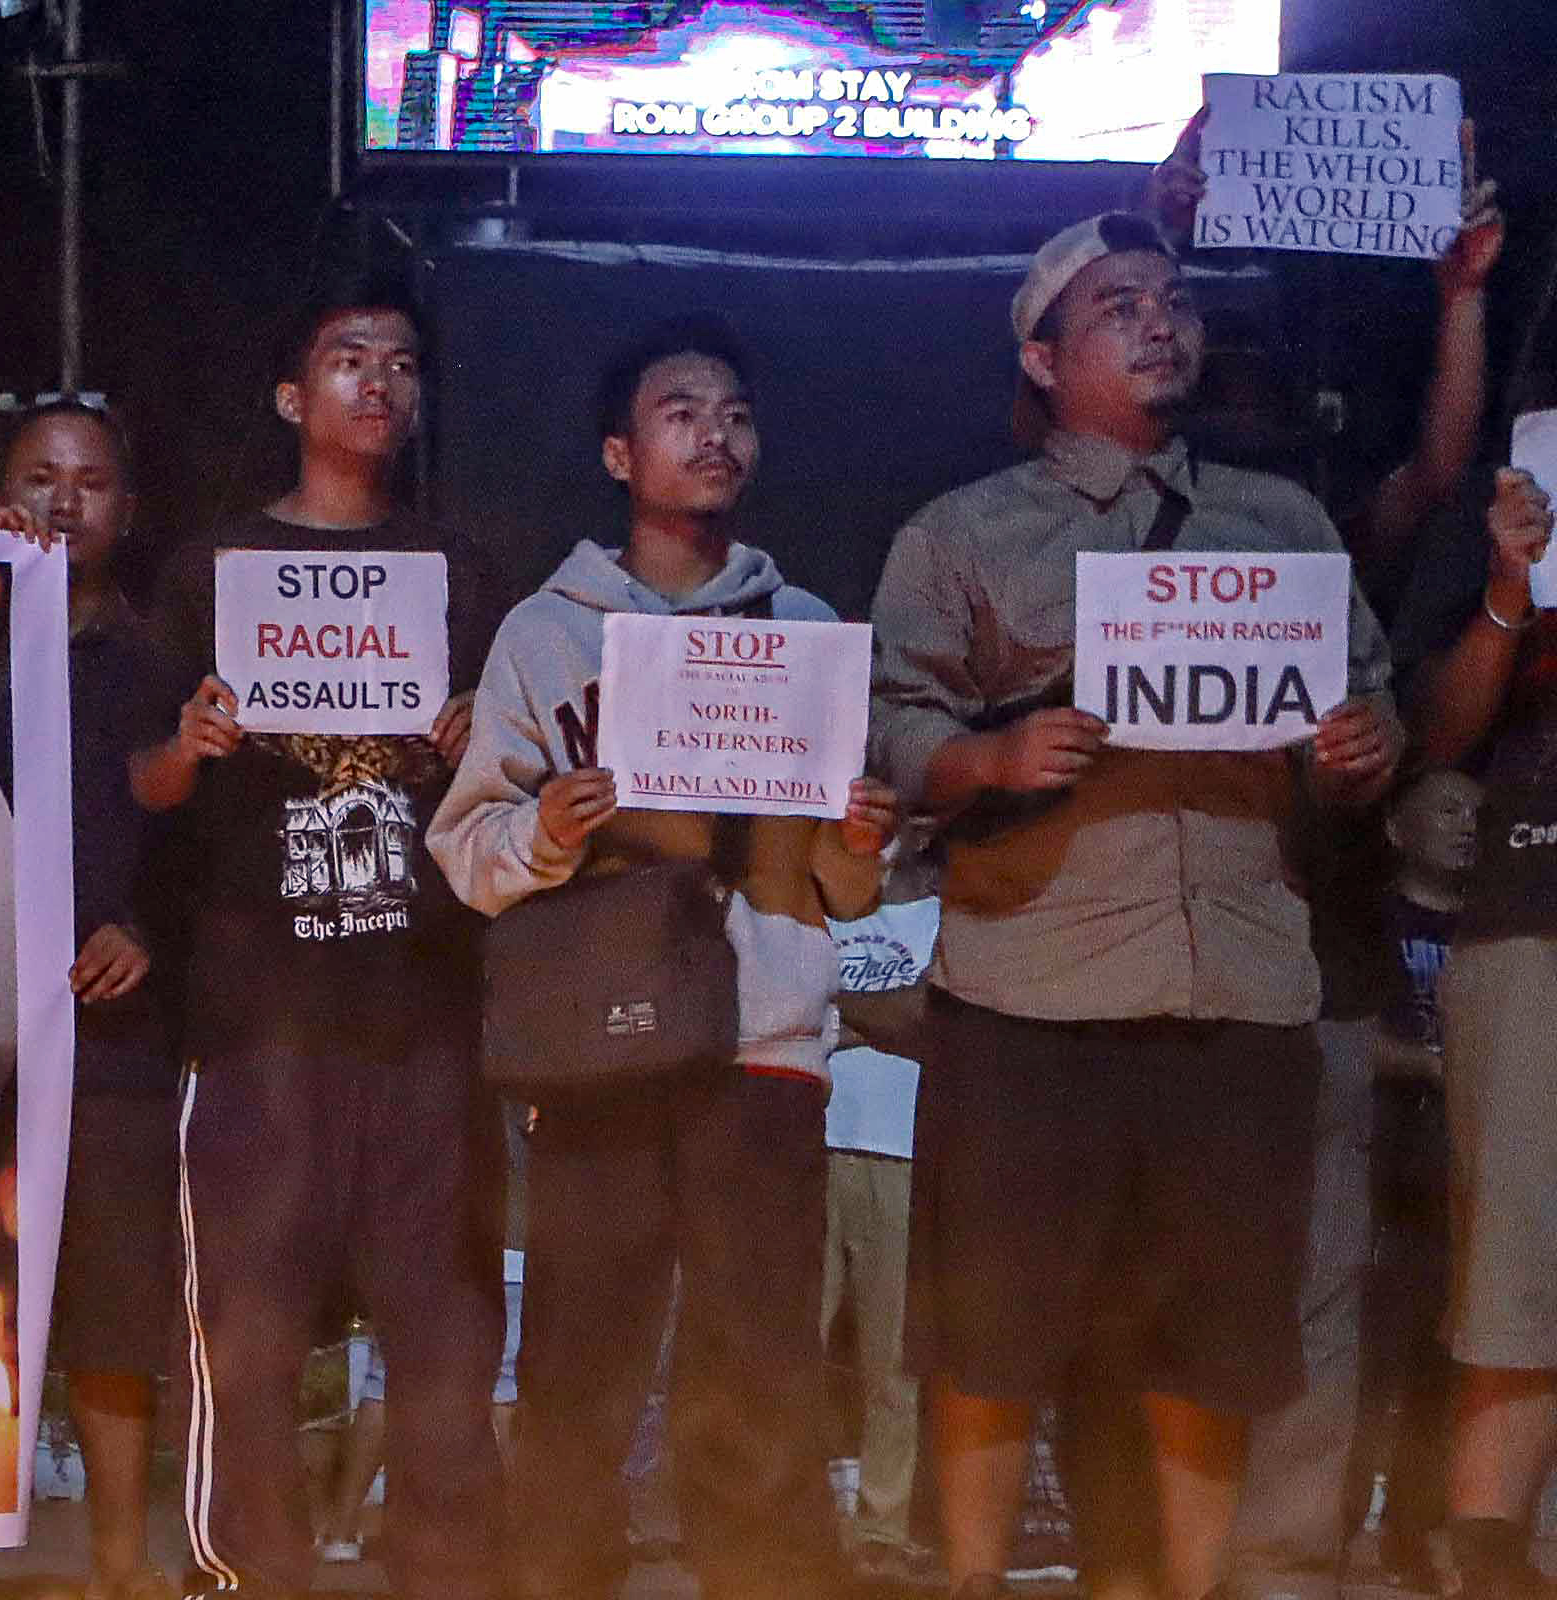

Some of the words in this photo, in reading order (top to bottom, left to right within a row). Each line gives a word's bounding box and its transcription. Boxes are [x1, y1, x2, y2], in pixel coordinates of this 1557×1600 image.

[819, 70, 911, 102] STAY
[1253, 79, 1435, 115] RACISM
[613, 102, 696, 135] ROM
[702, 103, 828, 137] GROUP
[833, 106, 856, 138] 2
[864, 105, 1032, 141] BUILDING
[1285, 117, 1411, 150] KILLS.
[1209, 149, 1292, 179] THE
[1305, 152, 1458, 188] WHOLE
[1253, 183, 1415, 222] WORLD
[1199, 215, 1232, 244] IS
[278, 564, 386, 599] STOP
[1147, 564, 1278, 603] STOP
[257, 623, 411, 658] RACIAL
[686, 630, 788, 661] STOP
[1101, 622, 1144, 641] THE
[1233, 622, 1324, 641] RACISM
[246, 681, 421, 709] ASSAULTS
[1106, 664, 1318, 726] INDIA
[689, 703, 778, 723] NORTH-
[656, 730, 809, 754] EASTERNERS
[633, 772, 757, 797] MAINLAND
[765, 779, 829, 801] INDIA
[294, 915, 336, 941] The
